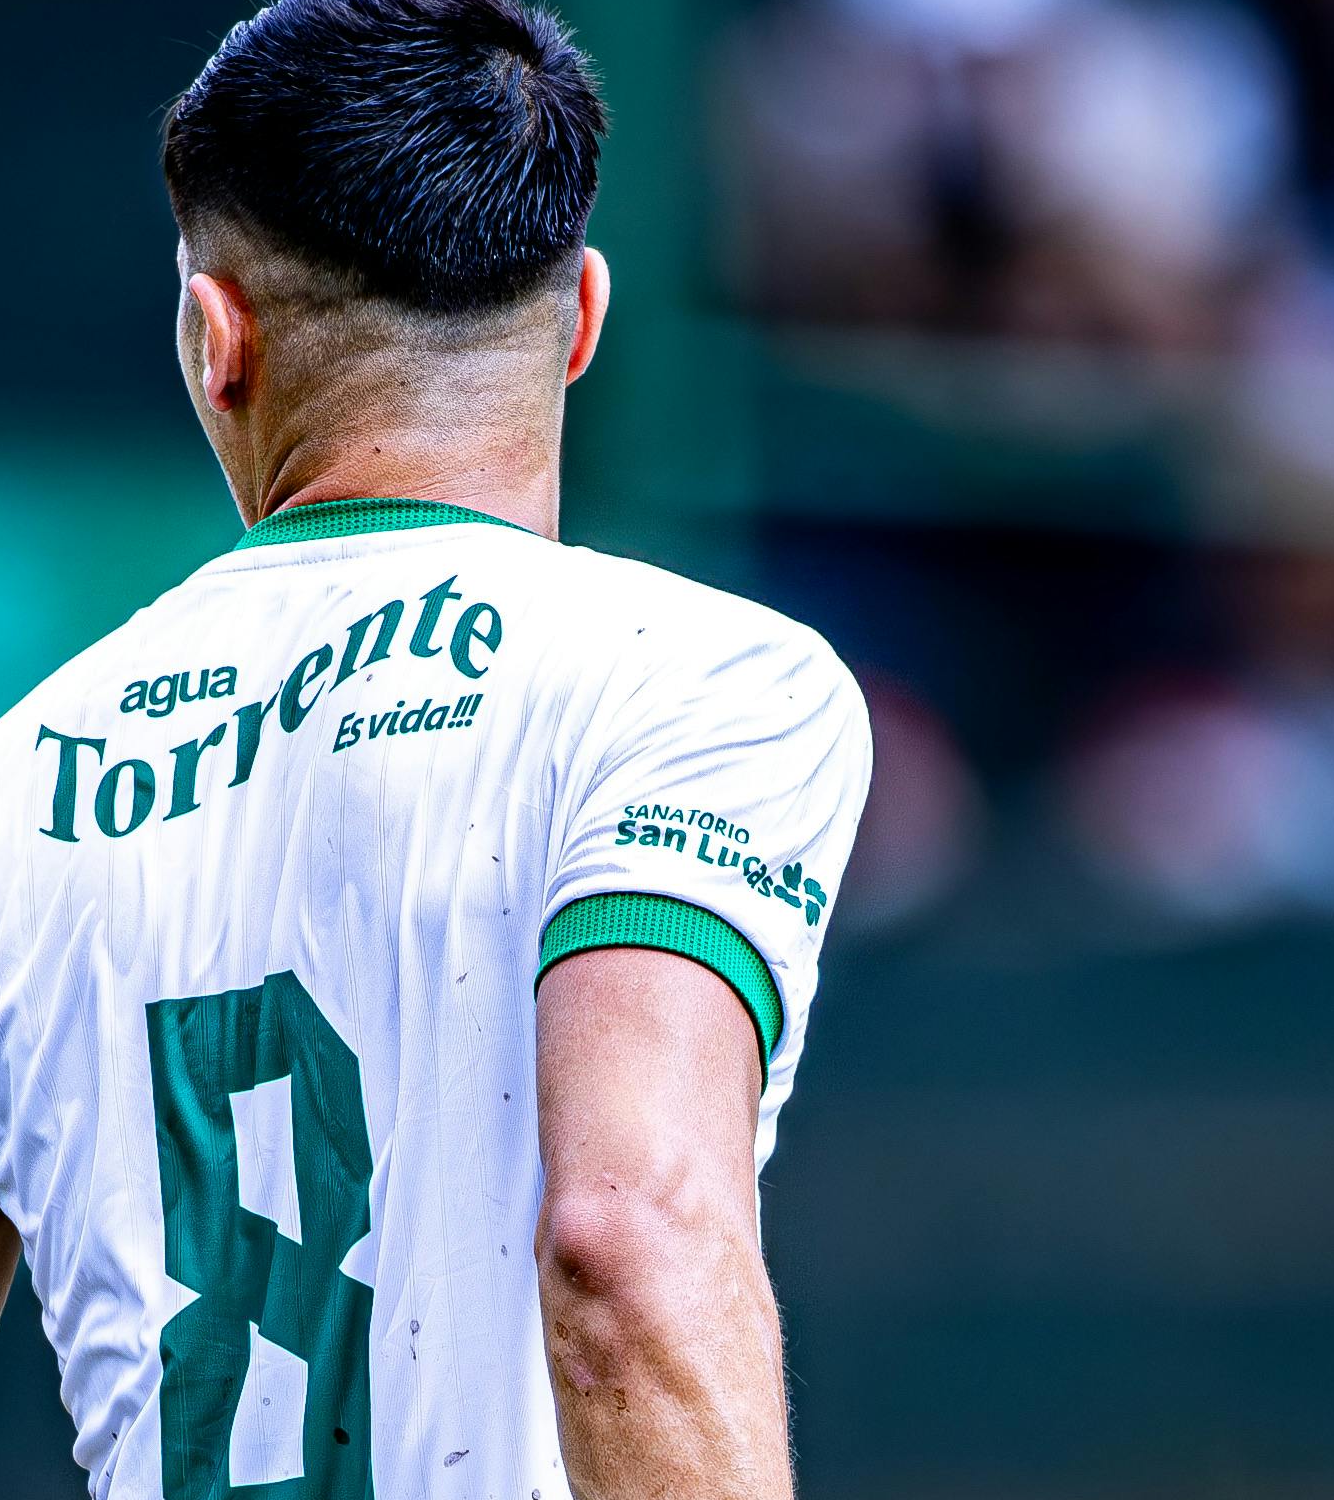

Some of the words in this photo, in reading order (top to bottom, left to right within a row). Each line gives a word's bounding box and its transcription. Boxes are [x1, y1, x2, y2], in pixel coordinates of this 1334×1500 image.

[35, 574, 503, 843] Torrente
[119, 665, 238, 718] agua
[624, 804, 750, 844] SANATORIO
[615, 819, 687, 853] San
[697, 833, 774, 897] Lucas
